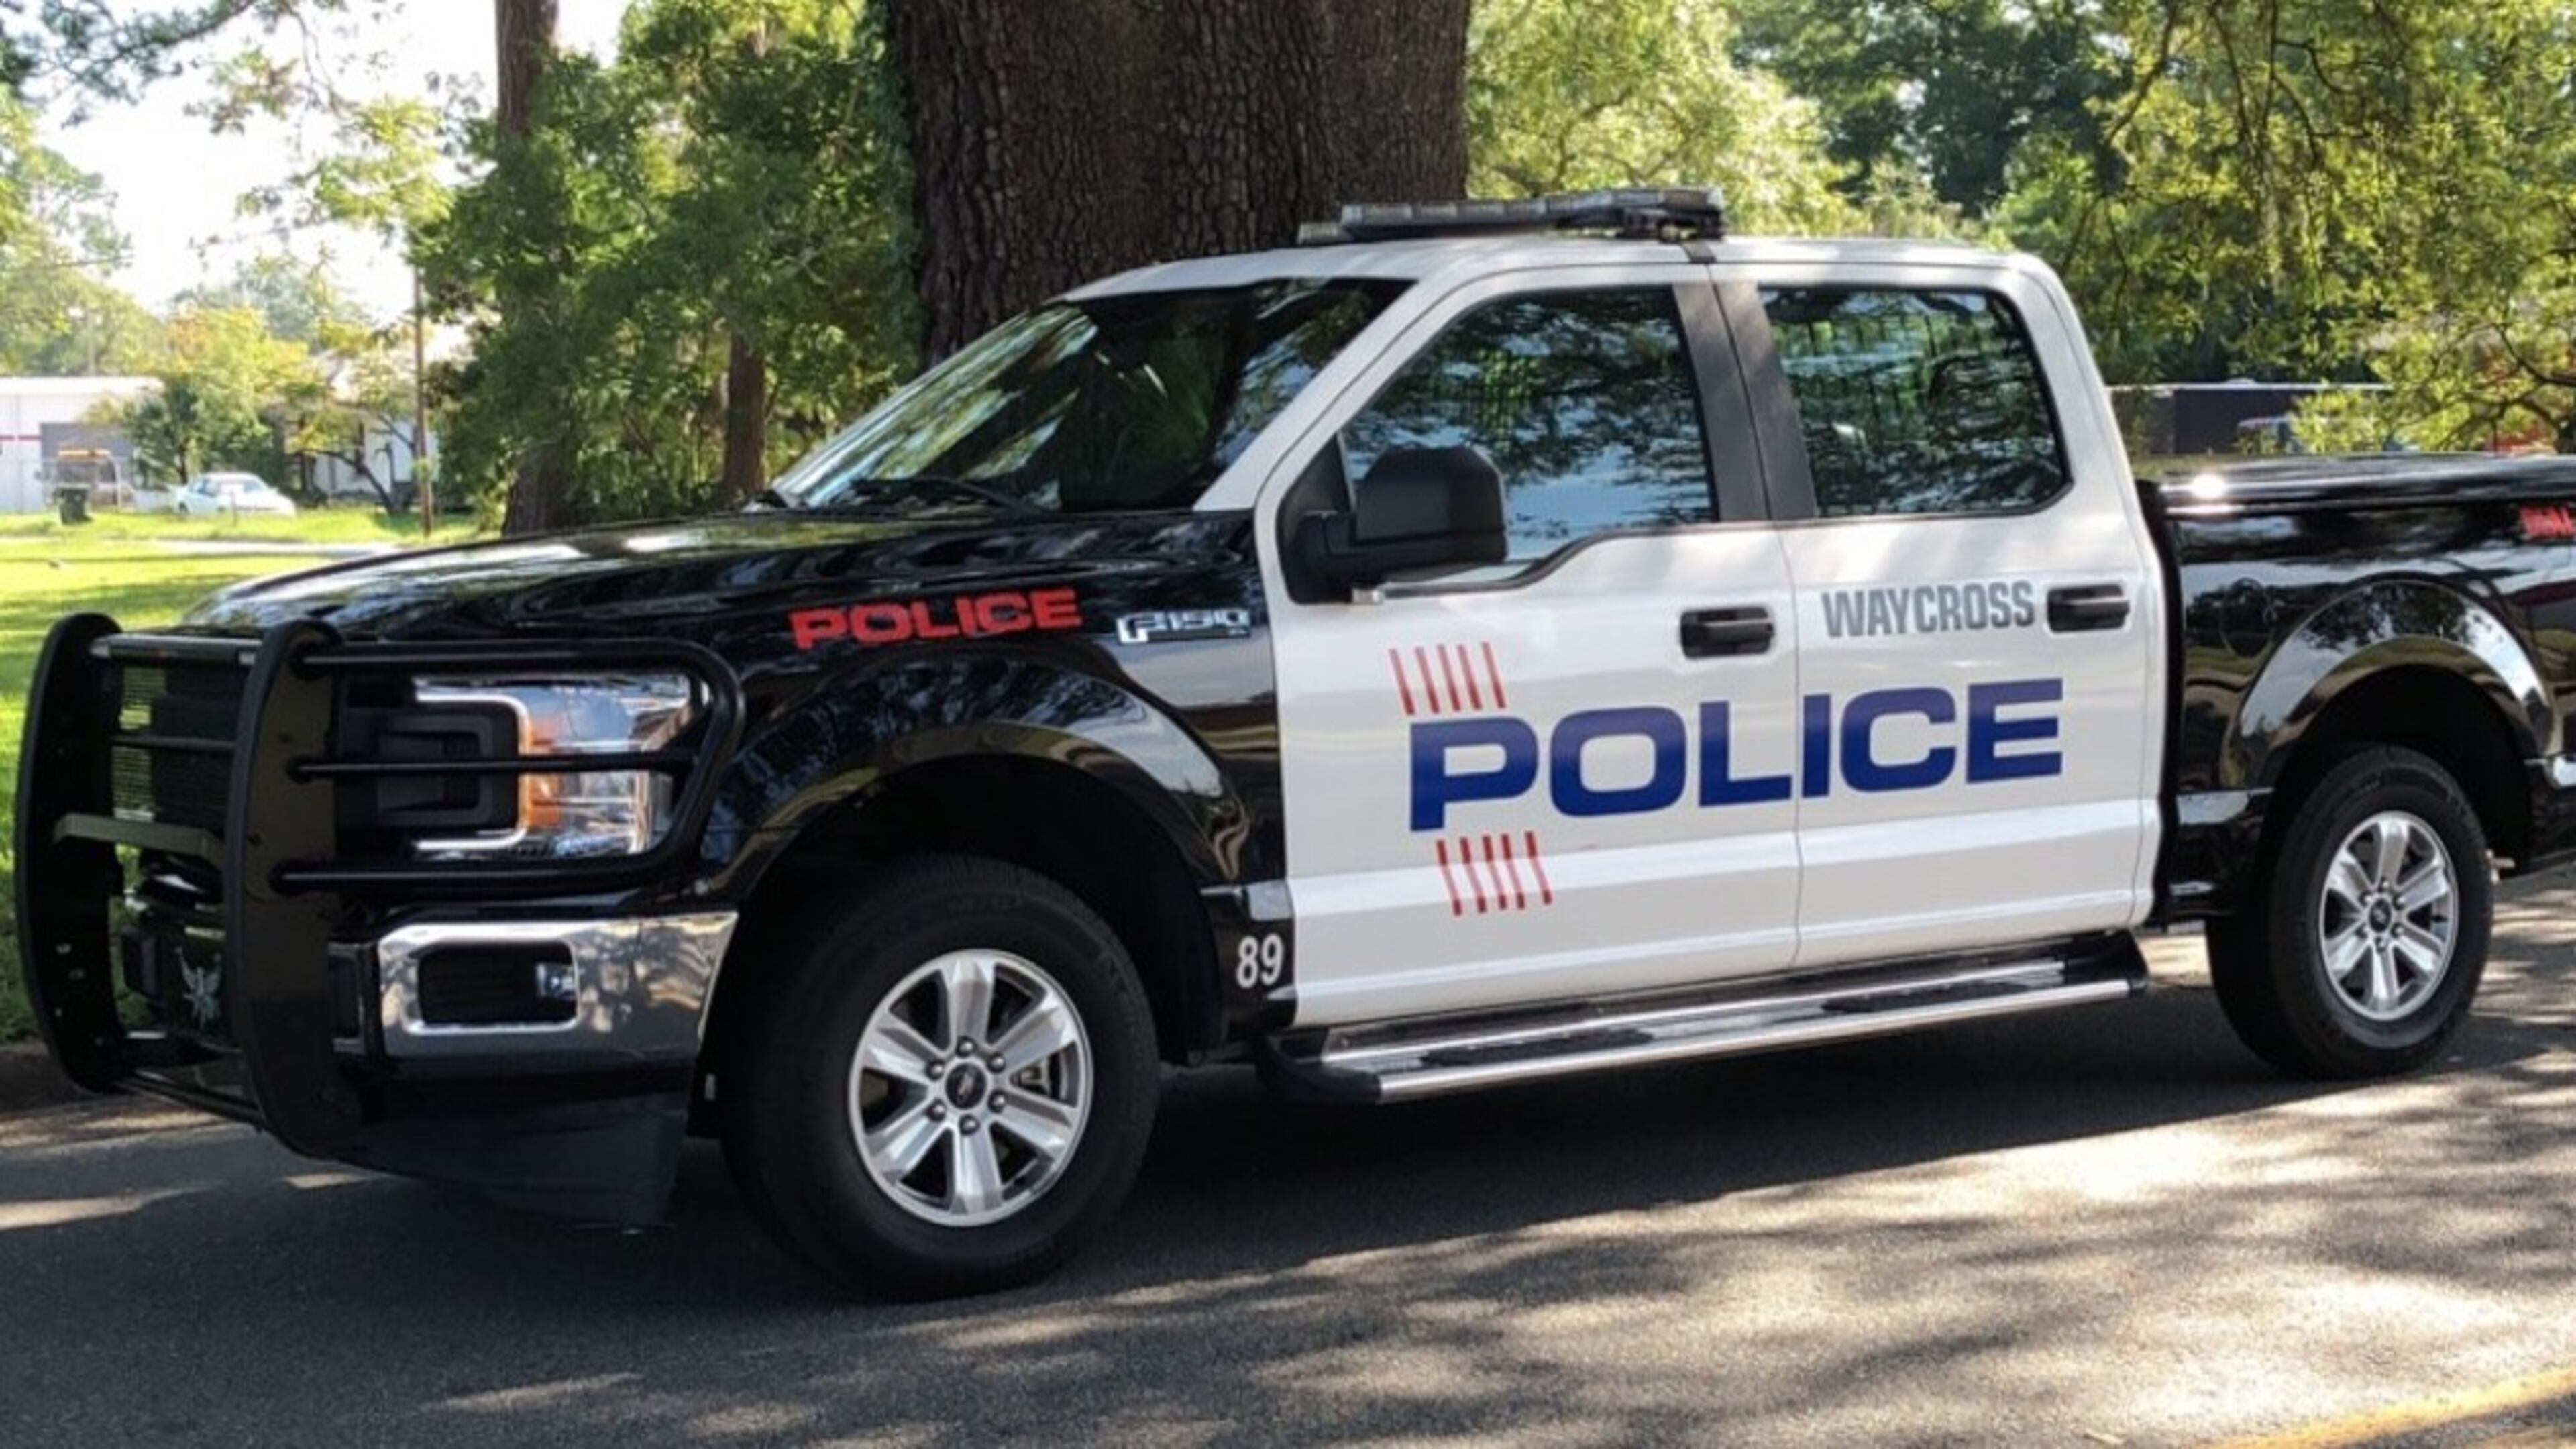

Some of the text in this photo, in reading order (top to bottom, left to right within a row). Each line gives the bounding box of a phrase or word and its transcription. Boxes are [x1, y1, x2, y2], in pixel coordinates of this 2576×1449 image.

[788, 588, 1081, 650] POLICE
[1821, 580, 2036, 638] WAYCROSS
[1409, 678, 2063, 833] POLICE
[1236, 933, 1283, 989] 89
